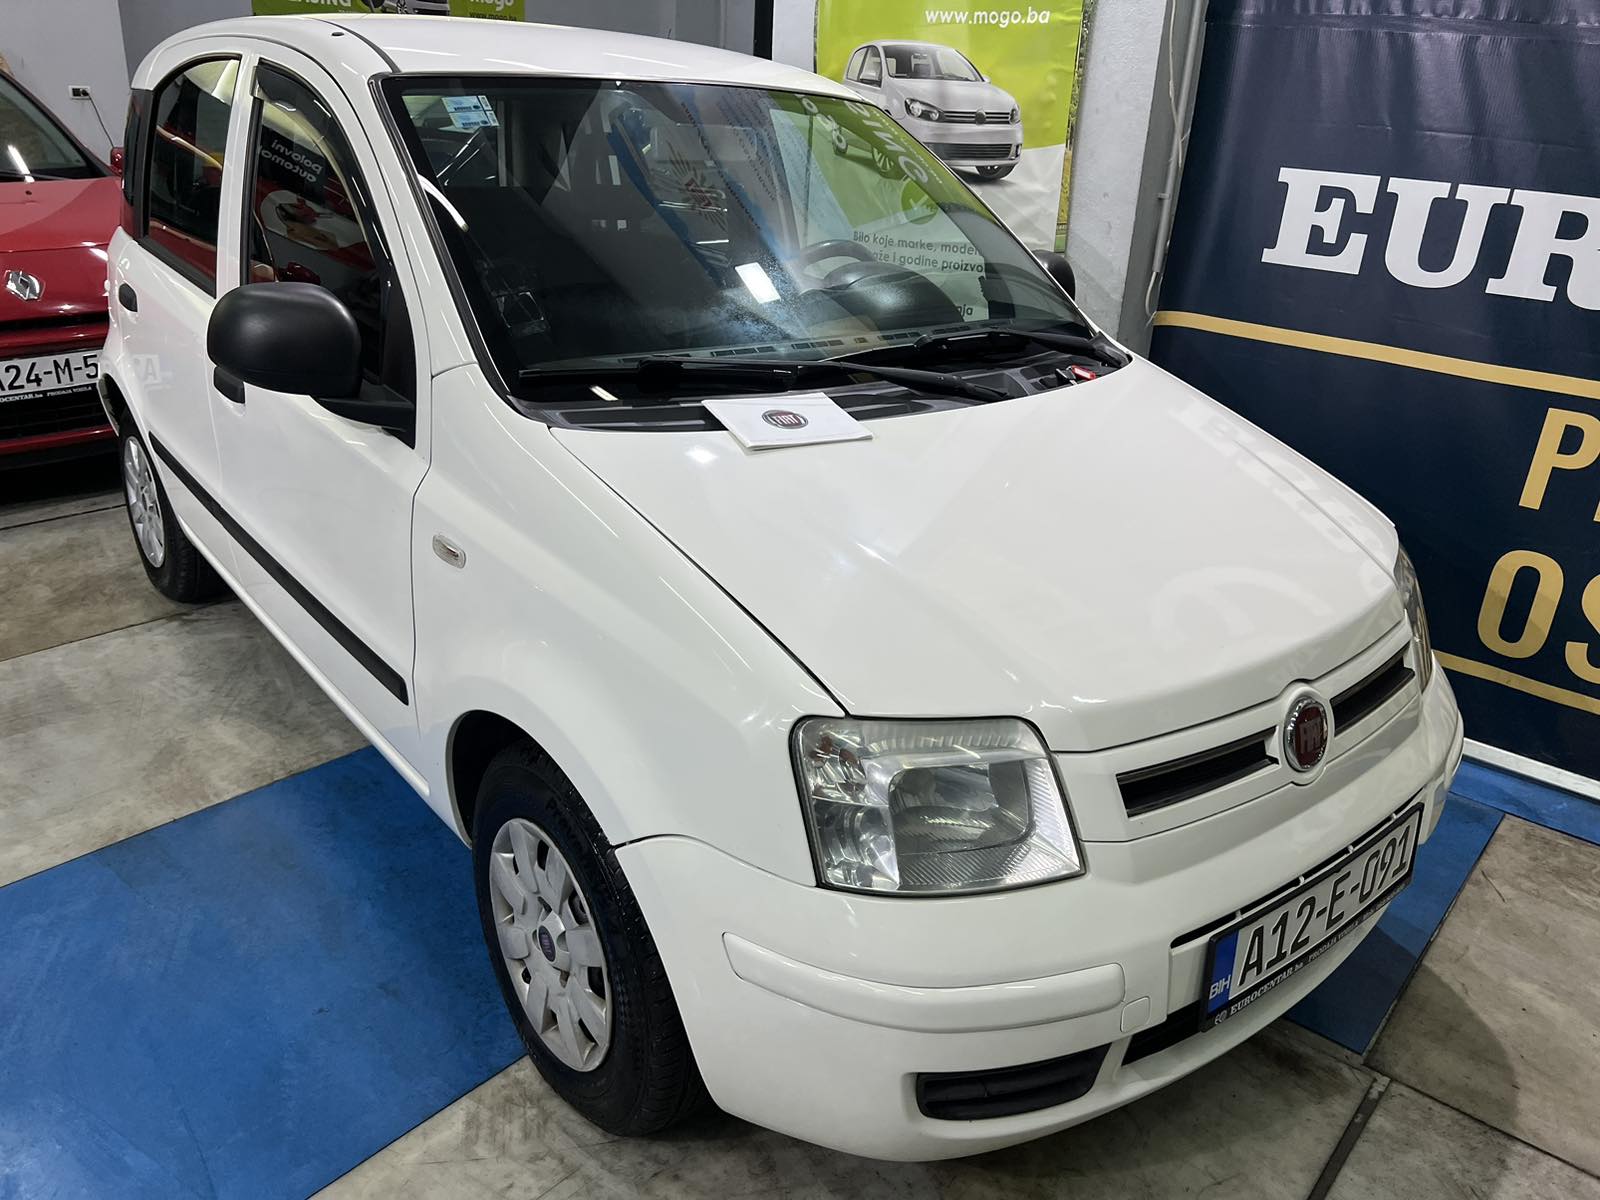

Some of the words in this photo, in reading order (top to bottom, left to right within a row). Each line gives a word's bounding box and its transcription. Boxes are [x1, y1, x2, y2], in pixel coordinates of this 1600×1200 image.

[925, 6, 1050, 28] www.mogo.ba
[853, 231, 870, 243] Bilo
[872, 234, 895, 248] koje
[897, 239, 937, 252] marke,
[0, 354, 99, 391] 24-M-5
[1518, 407, 1600, 522] P
[1237, 824, 1411, 987] A12-E-091
[1208, 974, 1231, 1001] BIH
